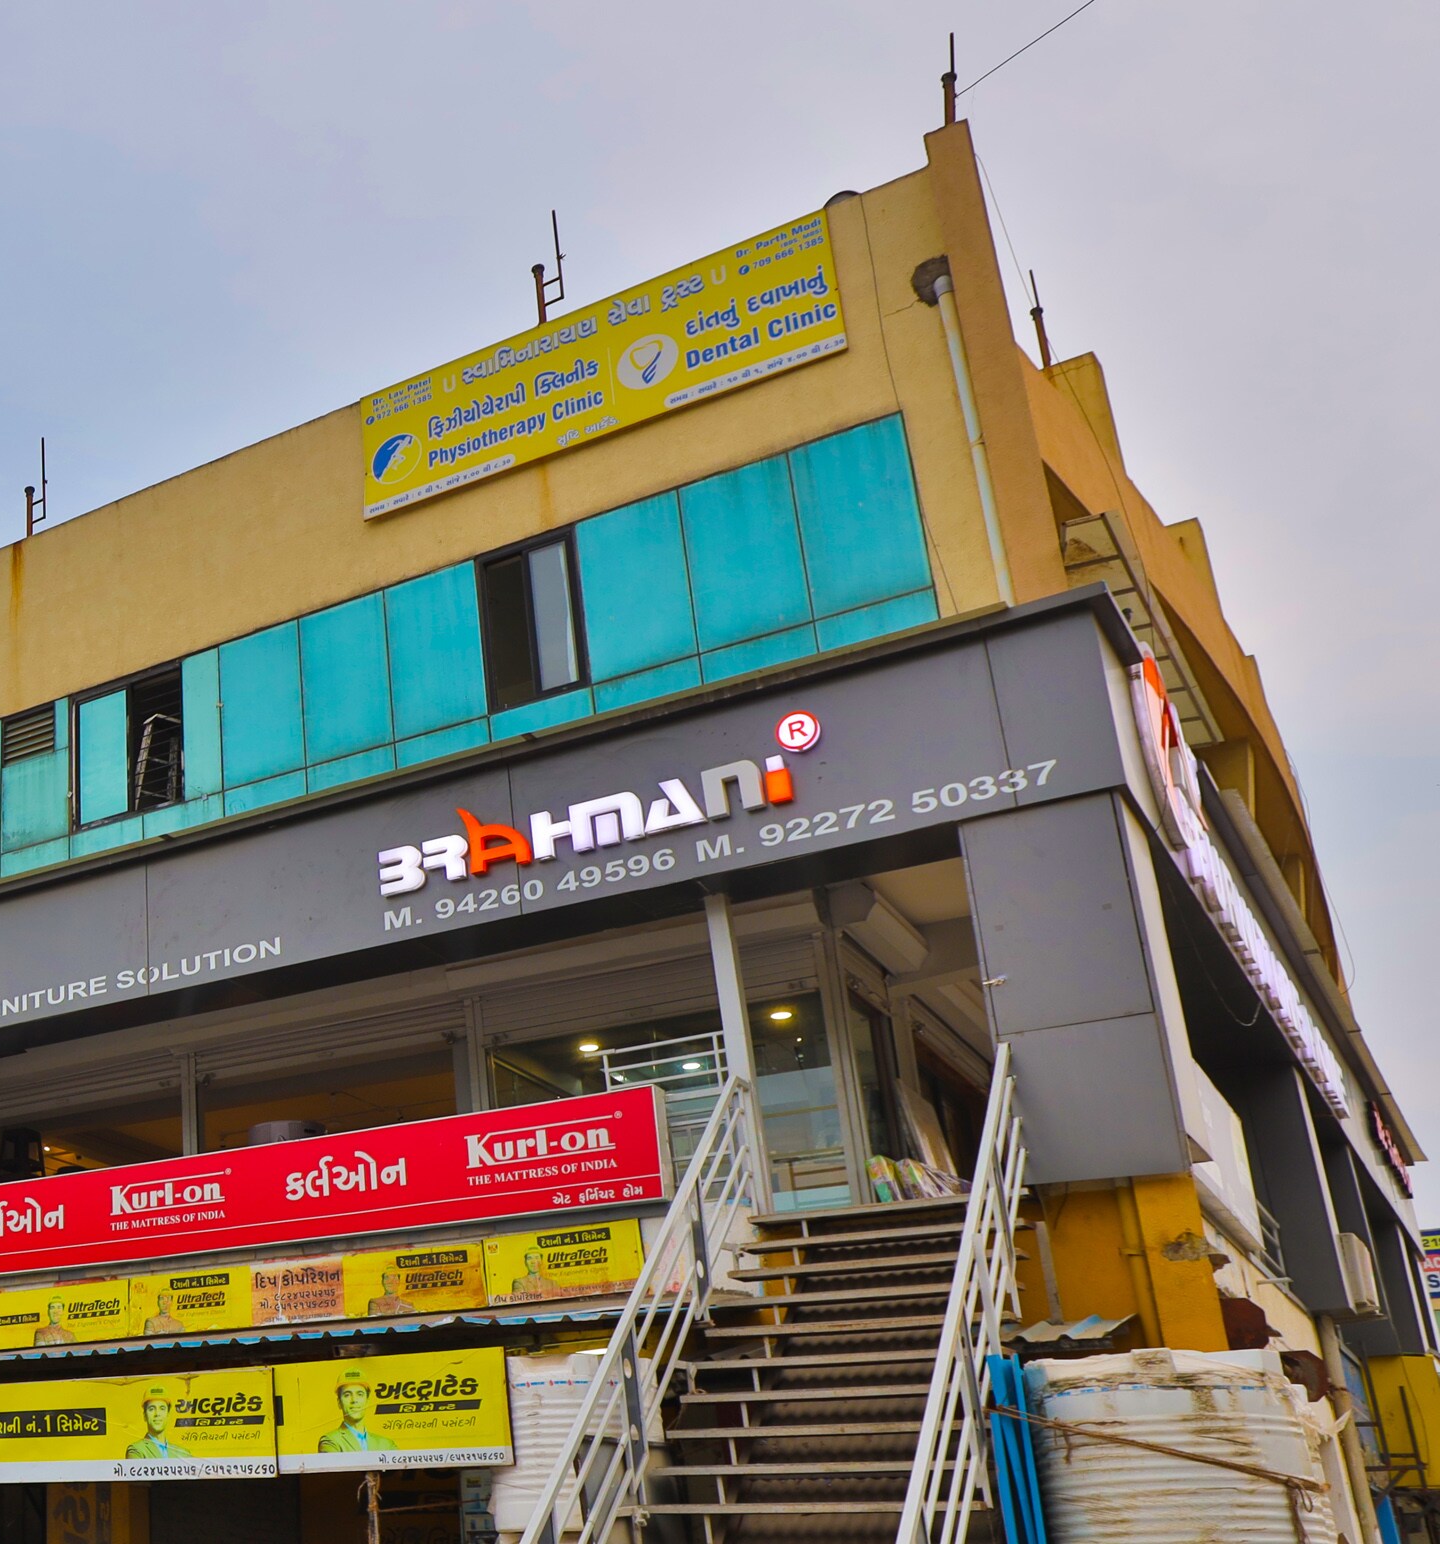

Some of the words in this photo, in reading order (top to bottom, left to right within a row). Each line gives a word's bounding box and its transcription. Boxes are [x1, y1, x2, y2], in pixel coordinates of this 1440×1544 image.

[755, 232, 787, 250] Parth
[798, 235, 824, 251] 1385
[747, 265, 829, 313] દવાખાનું
[462, 316, 598, 385] સ્વામિનારાયણ
[607, 294, 651, 327] સેવા
[686, 328, 760, 369] Dental
[768, 303, 838, 339] Clinic
[407, 376, 431, 392] Patel
[428, 412, 545, 469] Physiotherapy
[551, 390, 604, 423] Clinic
[383, 907, 423, 931] M.
[435, 879, 544, 919] 94260
[557, 848, 676, 893] 49596
[695, 836, 747, 865] M.
[758, 800, 897, 848] 92272
[910, 758, 1059, 815] 50337
[116, 936, 282, 990] SOLUTION
[464, 1122, 616, 1169] Kurl-on
[467, 1174, 492, 1186] THE
[494, 1166, 559, 1184] MATTRESS
[561, 1162, 580, 1174] OF
[582, 1158, 617, 1172] INDIA
[110, 1179, 225, 1216] Kurl-on
[623, 1184, 643, 1197] હોમ
[110, 1221, 129, 1231] THE
[130, 1215, 180, 1230] MATTRESS
[181, 1213, 196, 1225] OF
[197, 1210, 226, 1223] INDIA
[547, 1247, 608, 1264] UltraTech
[548, 1257, 608, 1269] CEMENT
[405, 1269, 463, 1284] UltraTech
[68, 1298, 120, 1313] UltraTech
[177, 1291, 225, 1304] UltraTech
[57, 1413, 99, 1432] સિમેન્ટ
